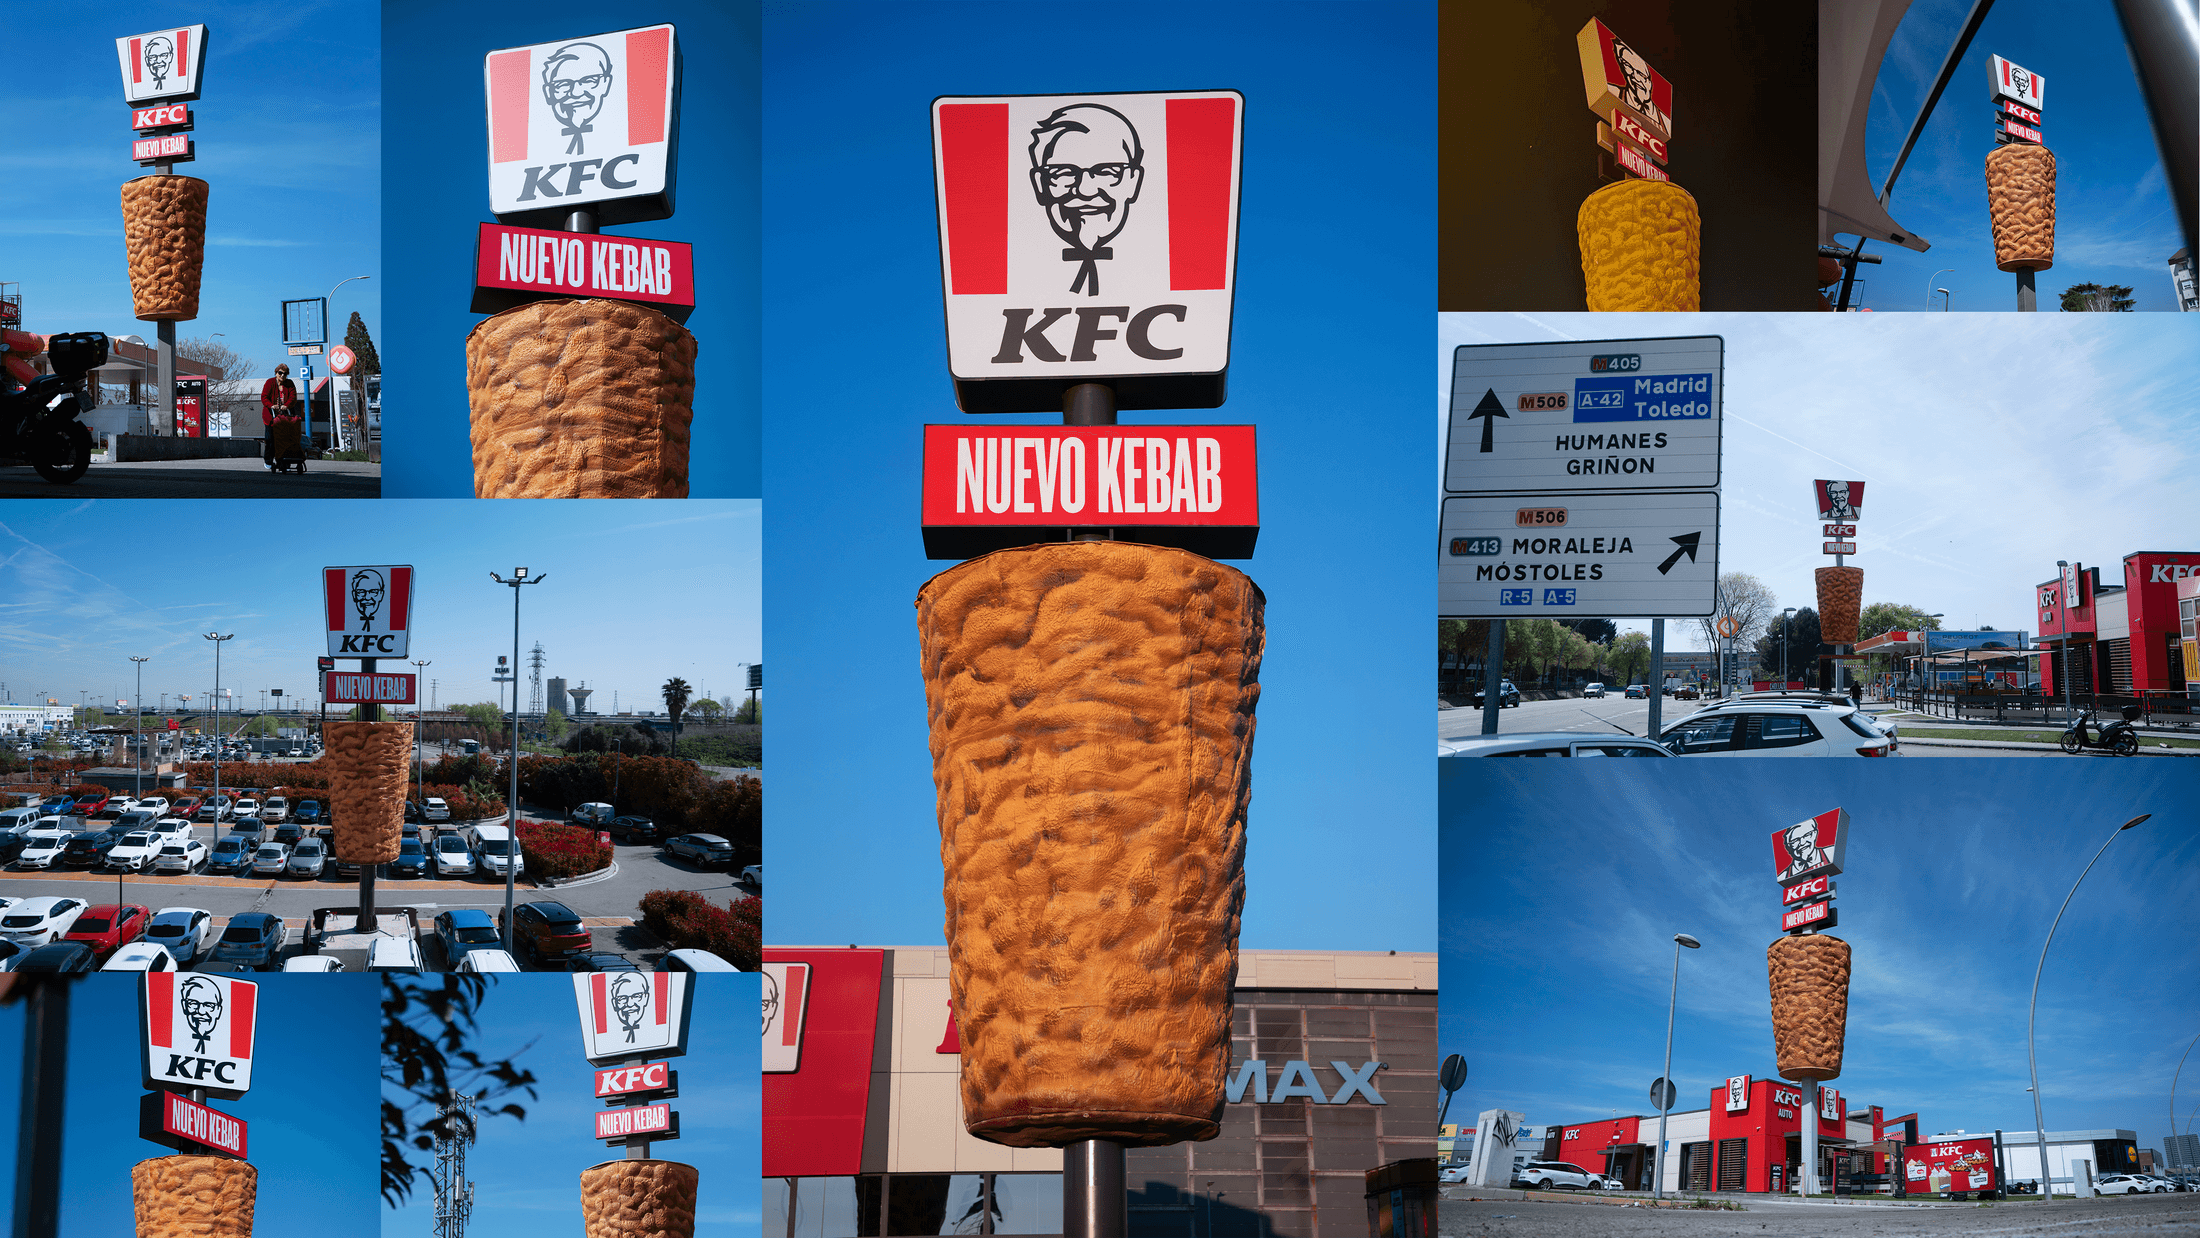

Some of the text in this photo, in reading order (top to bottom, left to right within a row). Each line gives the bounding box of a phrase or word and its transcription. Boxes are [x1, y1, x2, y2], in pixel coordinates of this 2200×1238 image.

[135, 106, 184, 127] KFC
[2008, 103, 2039, 123] KFC
[1619, 115, 1664, 156] KFC
[2008, 121, 2041, 143] NUEVO KEBAB
[136, 136, 184, 158] NUEVO KEBAB
[1621, 145, 1646, 177] NUEVO
[516, 154, 639, 202] KFC
[500, 232, 672, 295] NUEVO KEBAB
[3, 305, 17, 316] KFC
[991, 304, 1187, 364] KFC
[300, 367, 309, 379] P
[1634, 377, 1707, 395] Madrid
[1581, 393, 1621, 407] A-42
[1634, 401, 1709, 418] Toledo
[1556, 432, 1668, 451] HUMANES
[956, 437, 1222, 514] NUEVO KEBAB
[1566, 456, 1655, 475] GRIÑON
[1827, 525, 1854, 534] KFC
[1512, 537, 1633, 554] MORALEJA
[1476, 561, 1604, 581] MÓSTOLES
[1502, 590, 1575, 604] R-5 A-5
[2040, 590, 2056, 607] KFC
[339, 635, 395, 653] KFC
[336, 675, 406, 700] NUEVO KEBAB
[1785, 877, 1825, 903] KFC
[1785, 904, 1824, 928] NUEVO KEBAB
[165, 1053, 236, 1084] KFC
[599, 1065, 663, 1094] KFC
[1773, 1089, 1800, 1107] KFC
[600, 1106, 665, 1135] NUEVO KEBAB
[1778, 1108, 1793, 1119] AUTO
[172, 1098, 239, 1152] NUEVO KEBAB
[1564, 1129, 1581, 1141] KFC
[1939, 1145, 1963, 1157] KFC
